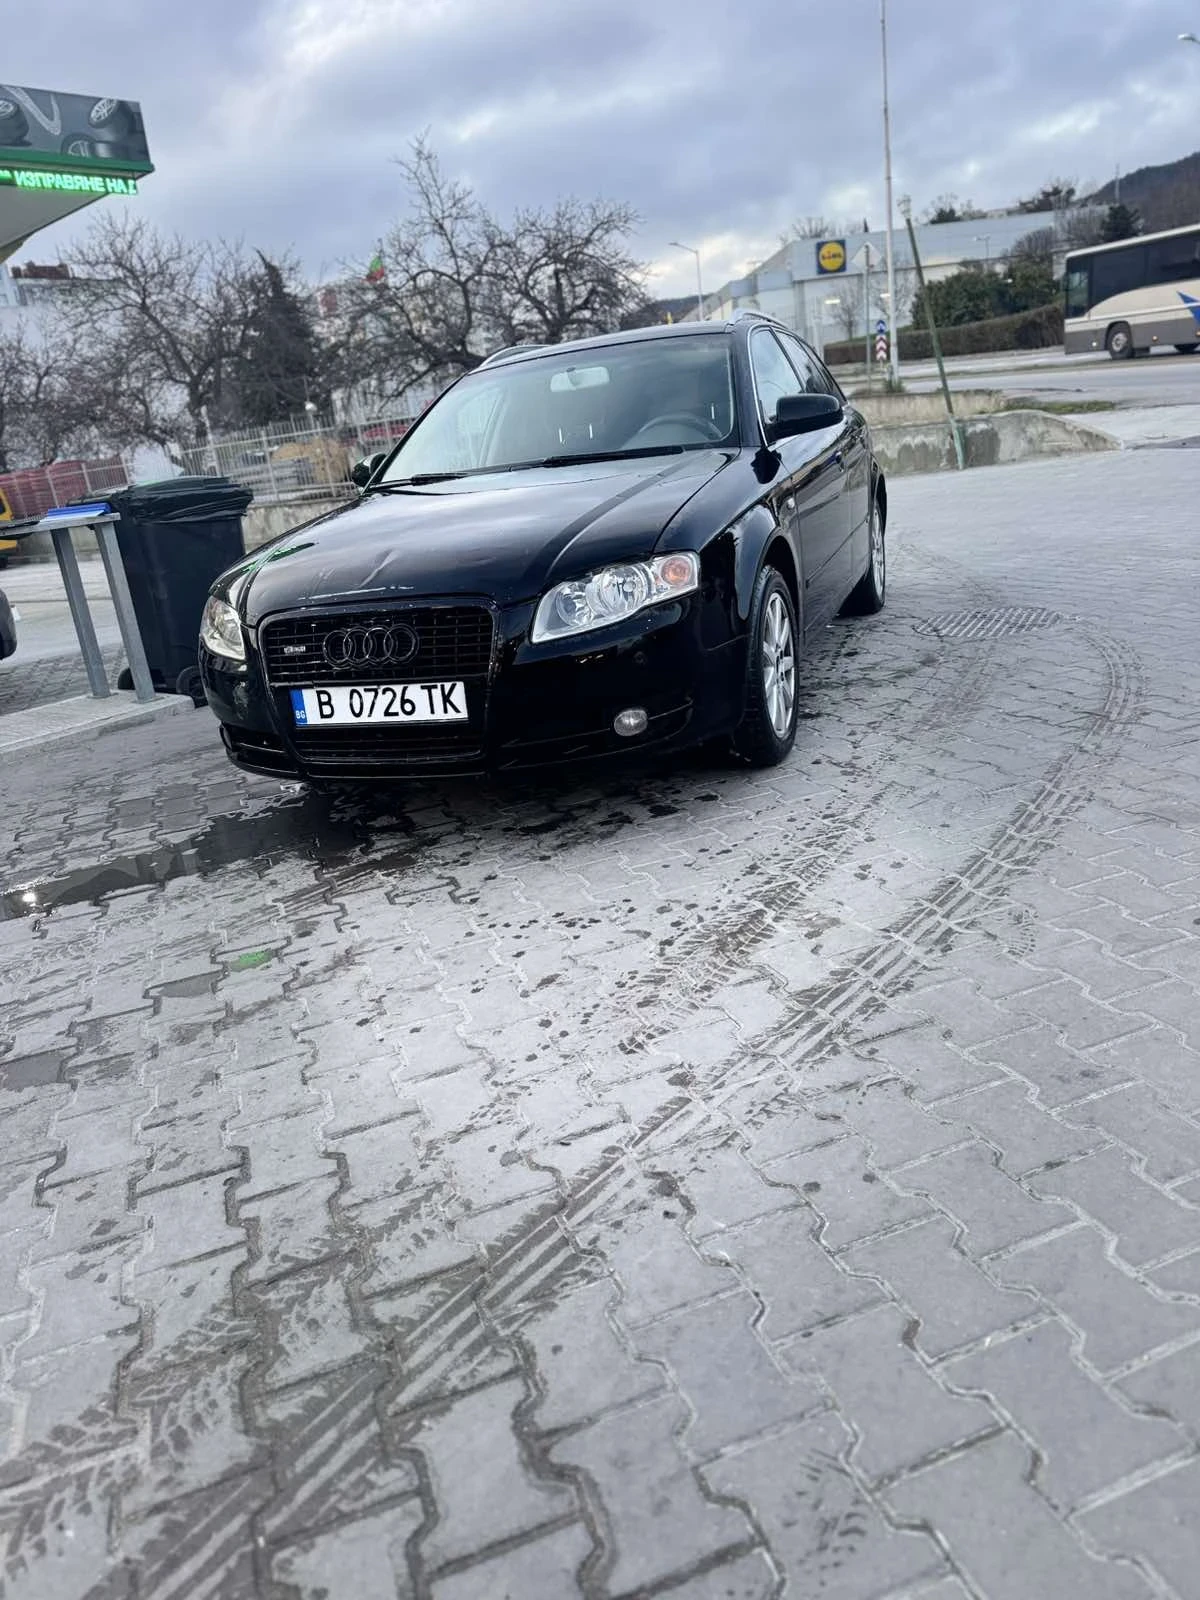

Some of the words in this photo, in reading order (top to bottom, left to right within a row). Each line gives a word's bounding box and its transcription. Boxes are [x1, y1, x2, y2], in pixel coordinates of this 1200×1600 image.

[14, 170, 105, 192] ИЗПРАВЯНЕ
[105, 177, 128, 193] НА
[316, 690, 335, 719] B
[349, 686, 416, 718] 0726
[421, 683, 461, 715] TK
[295, 710, 306, 719] BG
